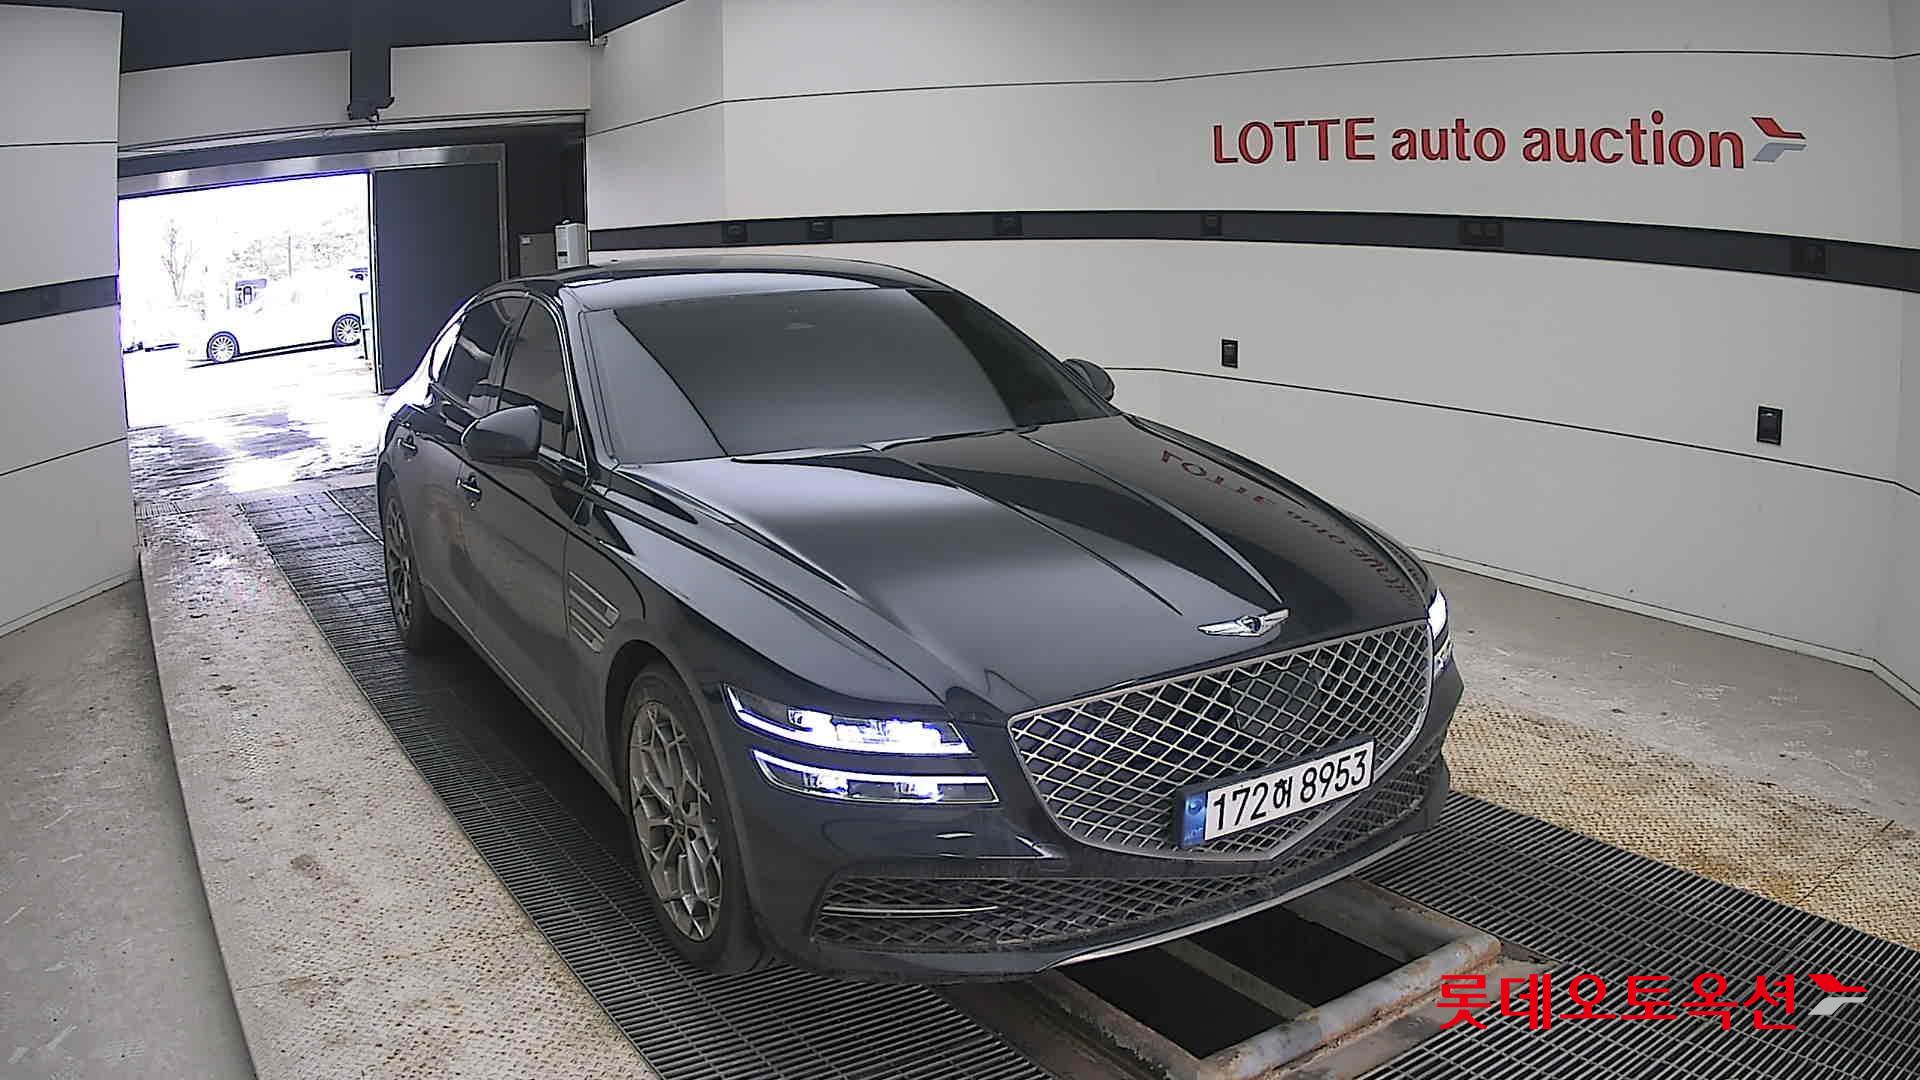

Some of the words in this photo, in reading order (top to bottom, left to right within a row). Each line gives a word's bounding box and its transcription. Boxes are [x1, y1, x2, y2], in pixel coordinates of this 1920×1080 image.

[1212, 117, 1375, 163] LOTTE
[1391, 118, 1507, 161] auto
[1522, 110, 1745, 169] auction
[1213, 775, 1293, 830] 172허
[1300, 750, 1368, 803] 8953
